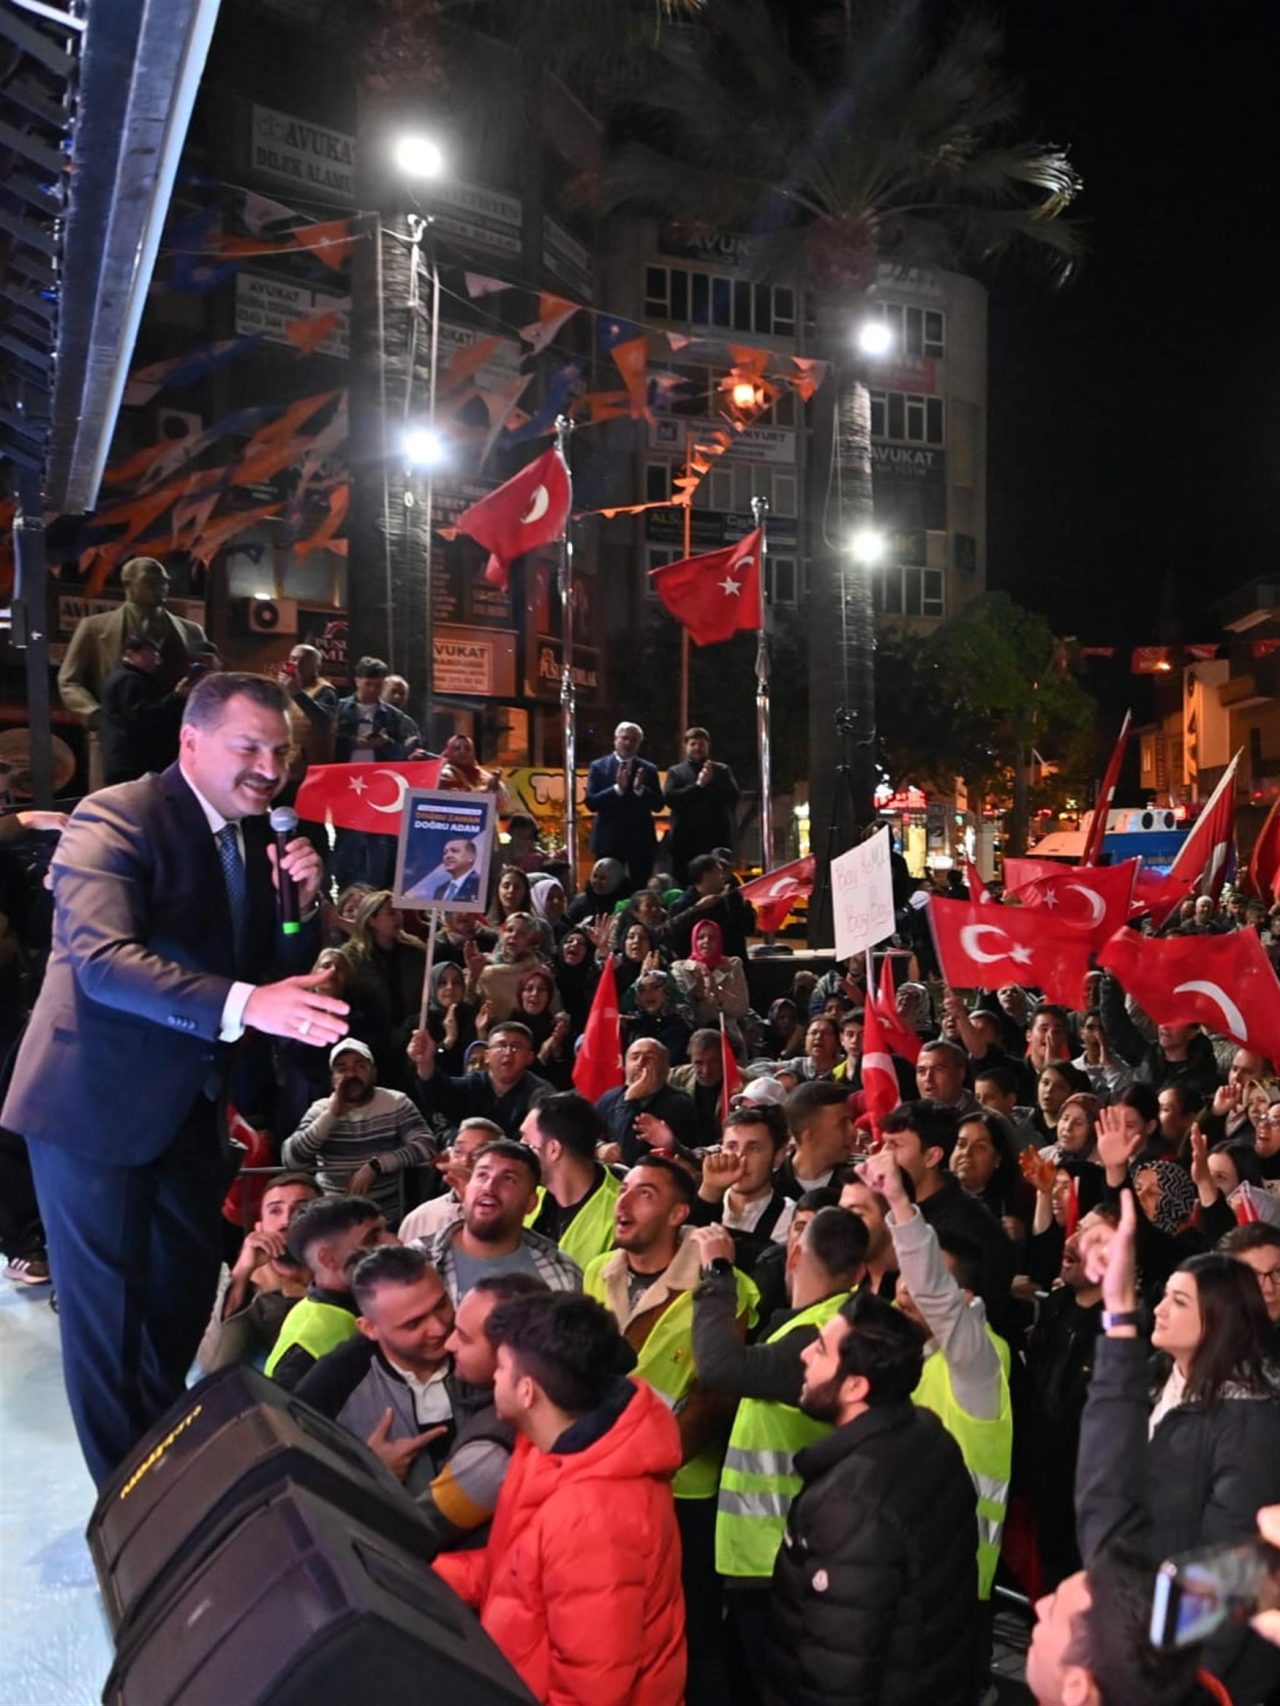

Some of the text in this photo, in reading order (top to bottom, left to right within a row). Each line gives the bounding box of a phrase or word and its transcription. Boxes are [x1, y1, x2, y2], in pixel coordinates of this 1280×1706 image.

[284, 121, 353, 165] AVUKA
[688, 234, 751, 256] AVUK
[870, 446, 936, 466] AVUKAT
[433, 644, 487, 659] VUKAT
[414, 820, 480, 833] DOĞRU ADAM
